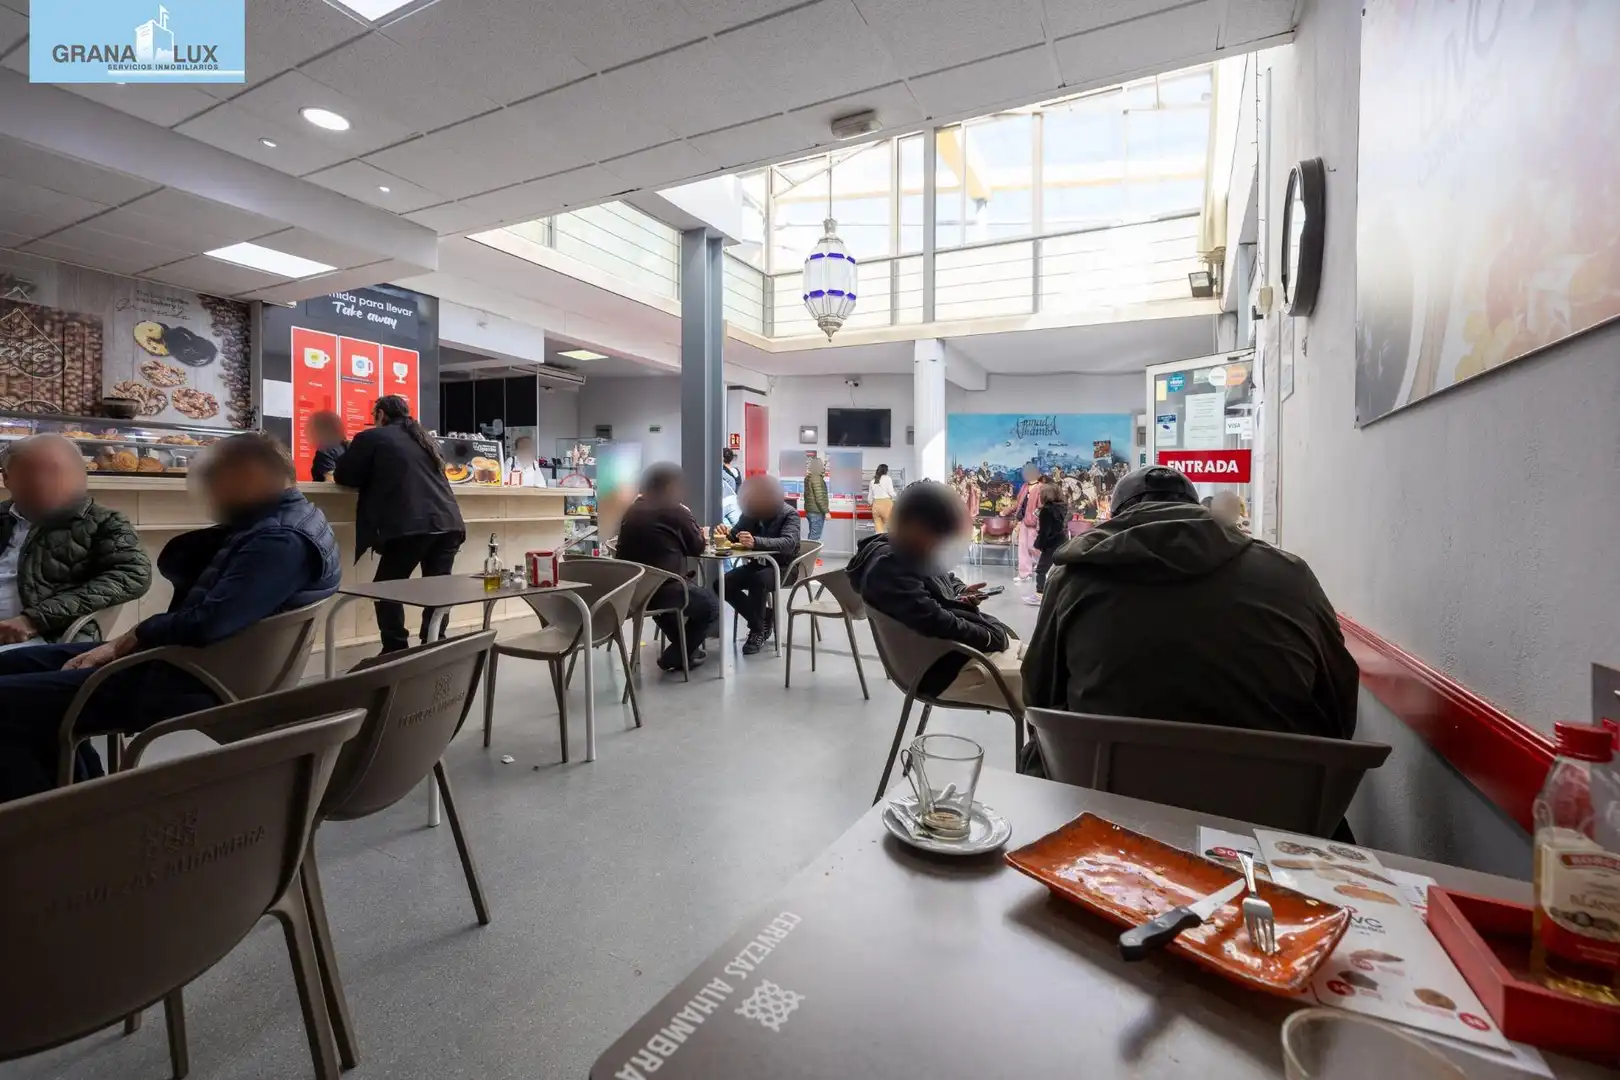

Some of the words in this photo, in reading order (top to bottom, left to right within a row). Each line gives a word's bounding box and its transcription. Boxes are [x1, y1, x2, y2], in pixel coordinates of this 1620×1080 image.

[332, 301, 363, 319] Take
[367, 311, 398, 330] away
[359, 297, 384, 310] para
[386, 302, 413, 317] llevar
[1166, 460, 1239, 473] ENTRADA
[724, 911, 802, 980] CERVEZAS
[614, 977, 734, 1080] ALHAMBRA
